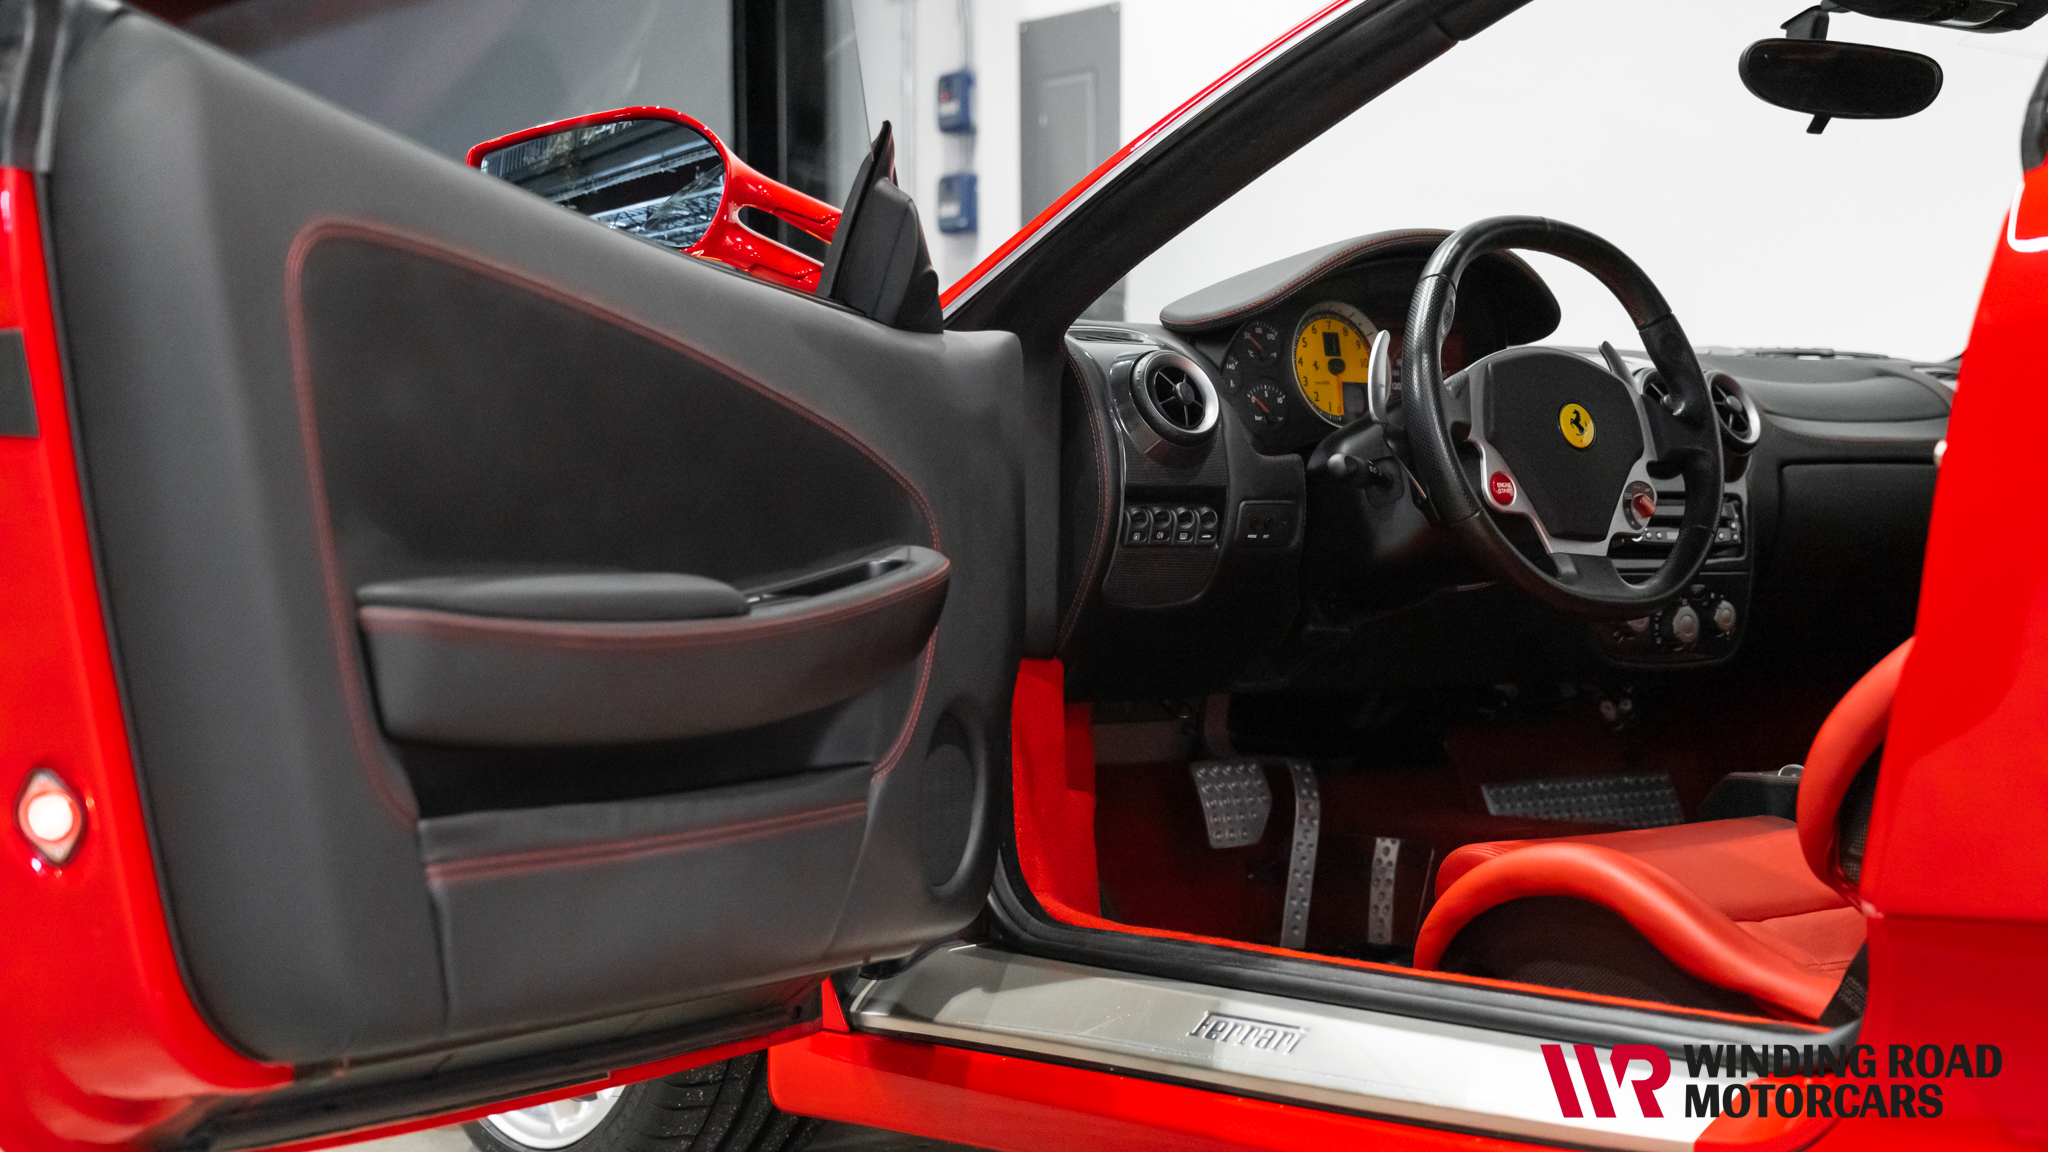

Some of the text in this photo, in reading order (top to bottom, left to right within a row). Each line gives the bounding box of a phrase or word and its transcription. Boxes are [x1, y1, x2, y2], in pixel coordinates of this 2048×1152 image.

[1311, 324, 1318, 334] 6
[1325, 320, 1332, 330] 7
[1342, 327, 1349, 337] 8
[1302, 337, 1308, 348] 5
[1355, 340, 1361, 350] 9
[1297, 356, 1304, 367] 4
[1360, 358, 1369, 369] 10
[1303, 376, 1309, 387] 3
[1313, 391, 1320, 402] 2
[1186, 1010, 1310, 1055] Ferrari
